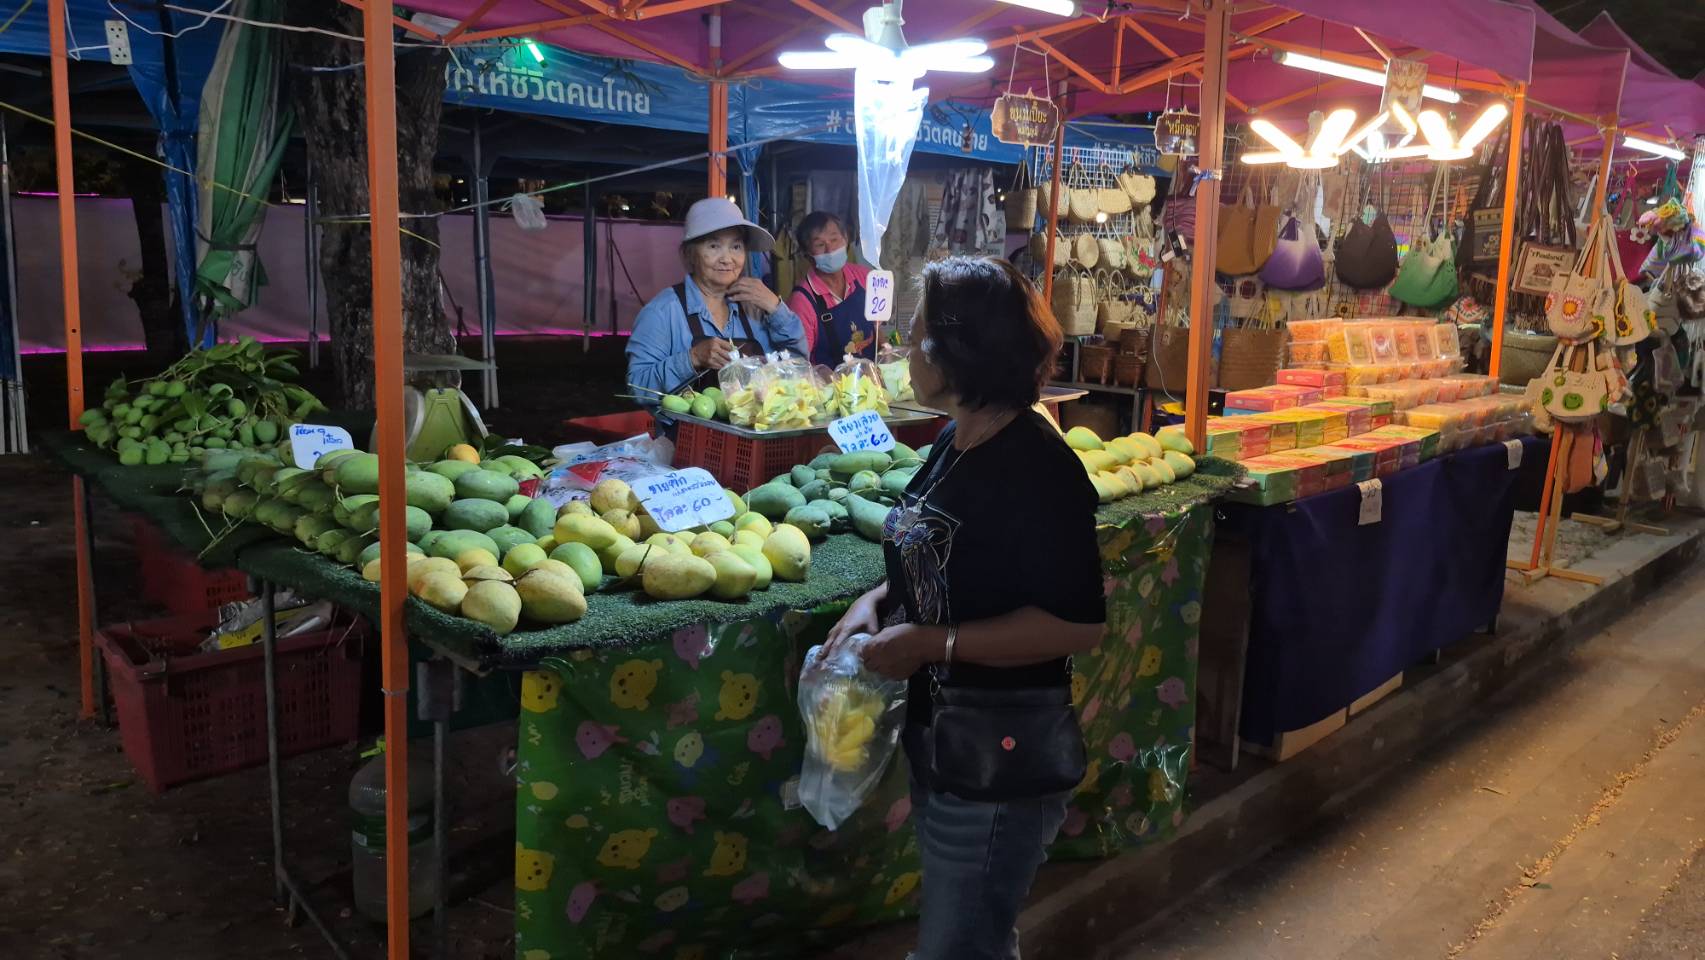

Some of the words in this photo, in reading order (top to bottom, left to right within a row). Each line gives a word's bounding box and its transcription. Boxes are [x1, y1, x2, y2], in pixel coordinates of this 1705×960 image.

[871, 296, 887, 315] 20
[870, 432, 889, 447] 60
[692, 497, 711, 512] 60
